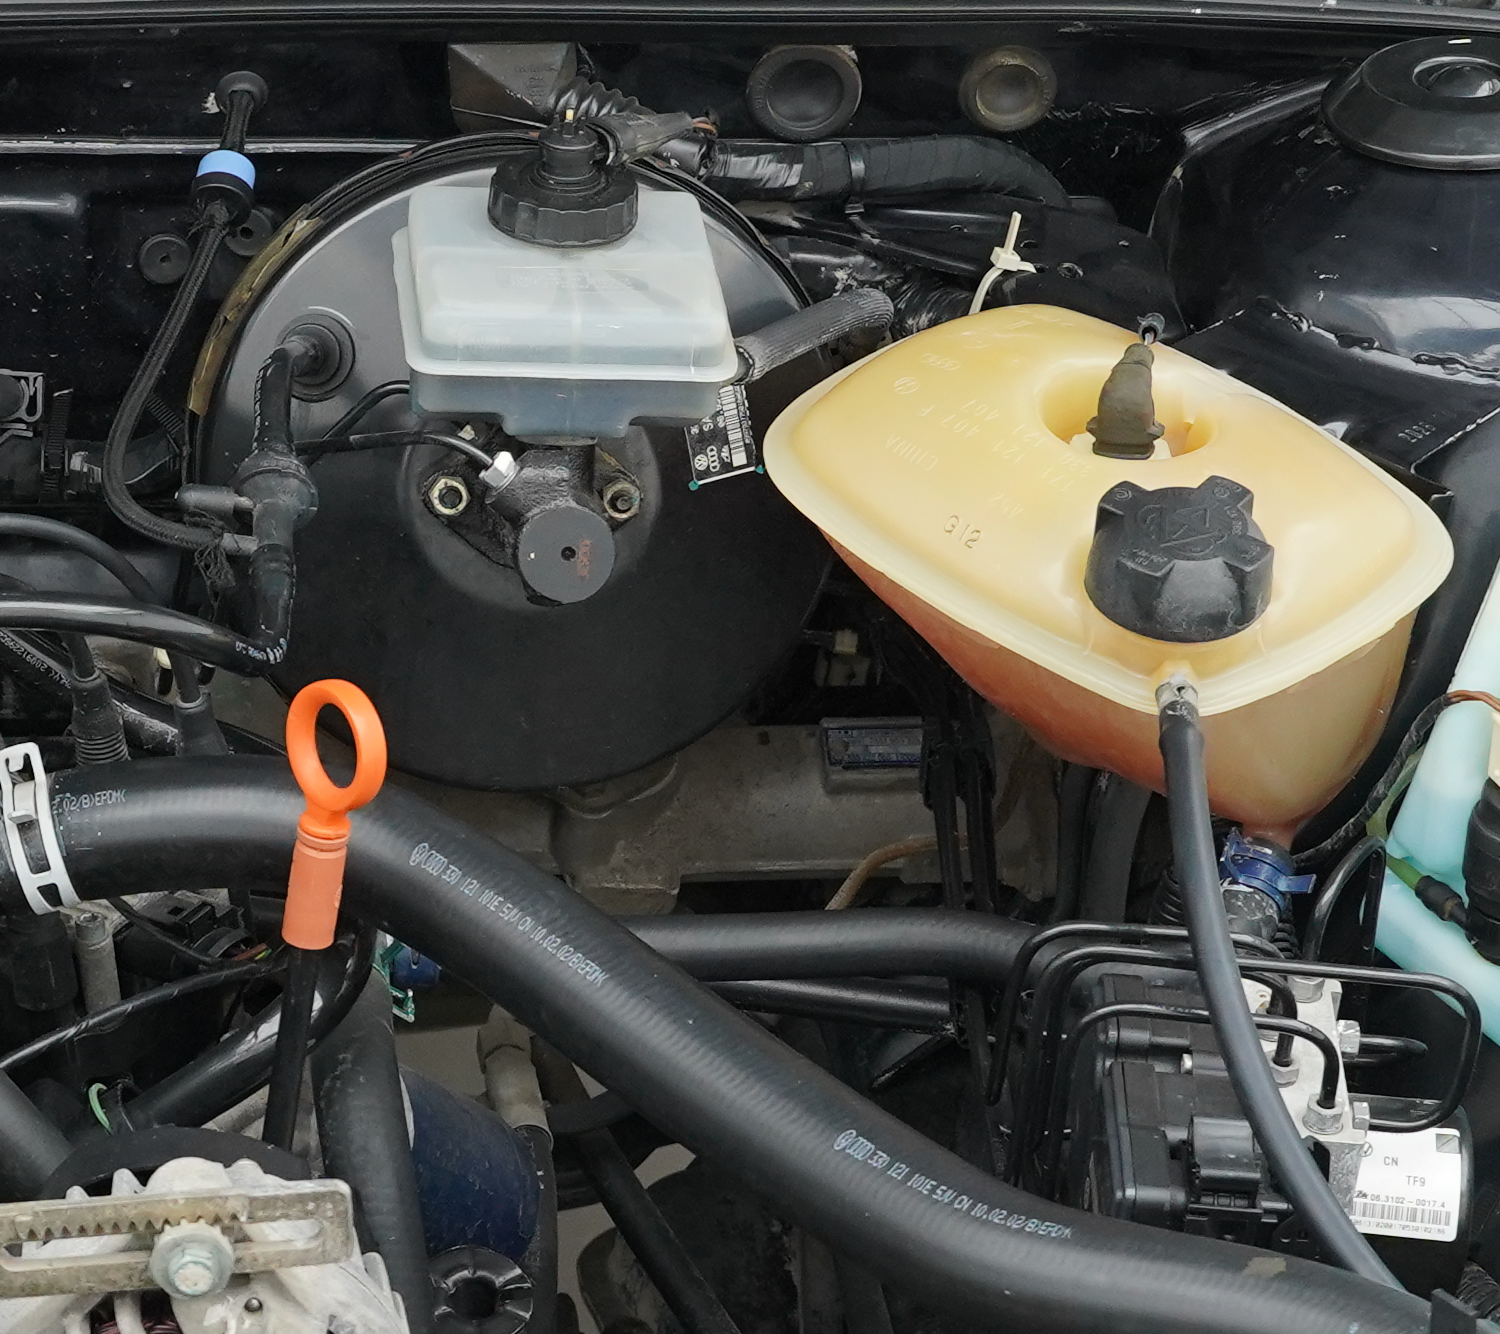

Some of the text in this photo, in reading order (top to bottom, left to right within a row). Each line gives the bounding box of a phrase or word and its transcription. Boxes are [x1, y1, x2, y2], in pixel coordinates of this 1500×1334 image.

[959, 399, 1000, 422] 407
[941, 414, 980, 439] 407
[991, 439, 1027, 465] 121
[943, 514, 982, 549] G12
[461, 877, 480, 898] 121
[479, 889, 500, 913] 101E
[1383, 1155, 1399, 1167] CN
[888, 1161, 909, 1182] 121
[908, 1172, 935, 1196] 101E
[1405, 1174, 1427, 1187] TF9
